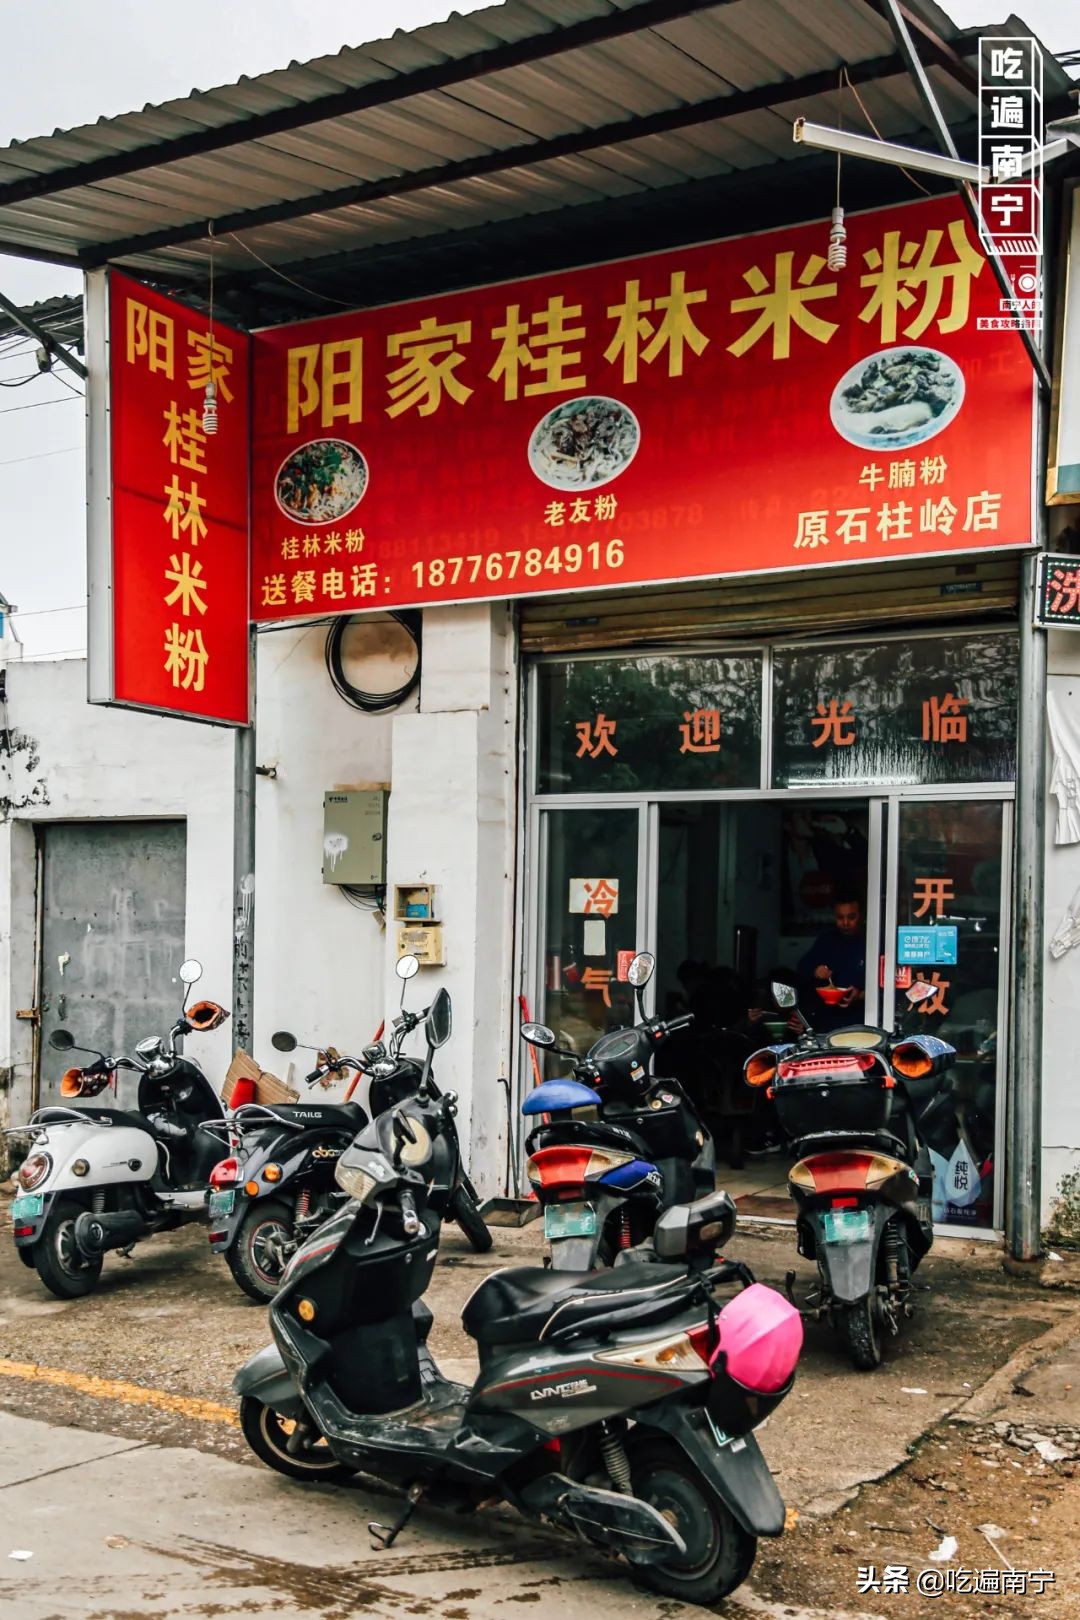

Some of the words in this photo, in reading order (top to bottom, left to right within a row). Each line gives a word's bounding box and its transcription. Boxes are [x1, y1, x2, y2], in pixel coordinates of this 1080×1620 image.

[126, 297, 235, 405] 阳家
[286, 218, 986, 434] 阳家桂林米粉
[859, 455, 948, 492] 牛腩粉
[544, 493, 618, 527] 老友粉
[793, 490, 1003, 550] 原石柱岭店
[163, 400, 210, 692] 桂林米粉
[281, 528, 365, 560] 桂林米粉
[411, 538, 626, 589] 18776784916
[575, 693, 970, 759] 欢迎光临
[581, 879, 618, 1008] 冷气
[954, 1161, 969, 1191] 纯悦
